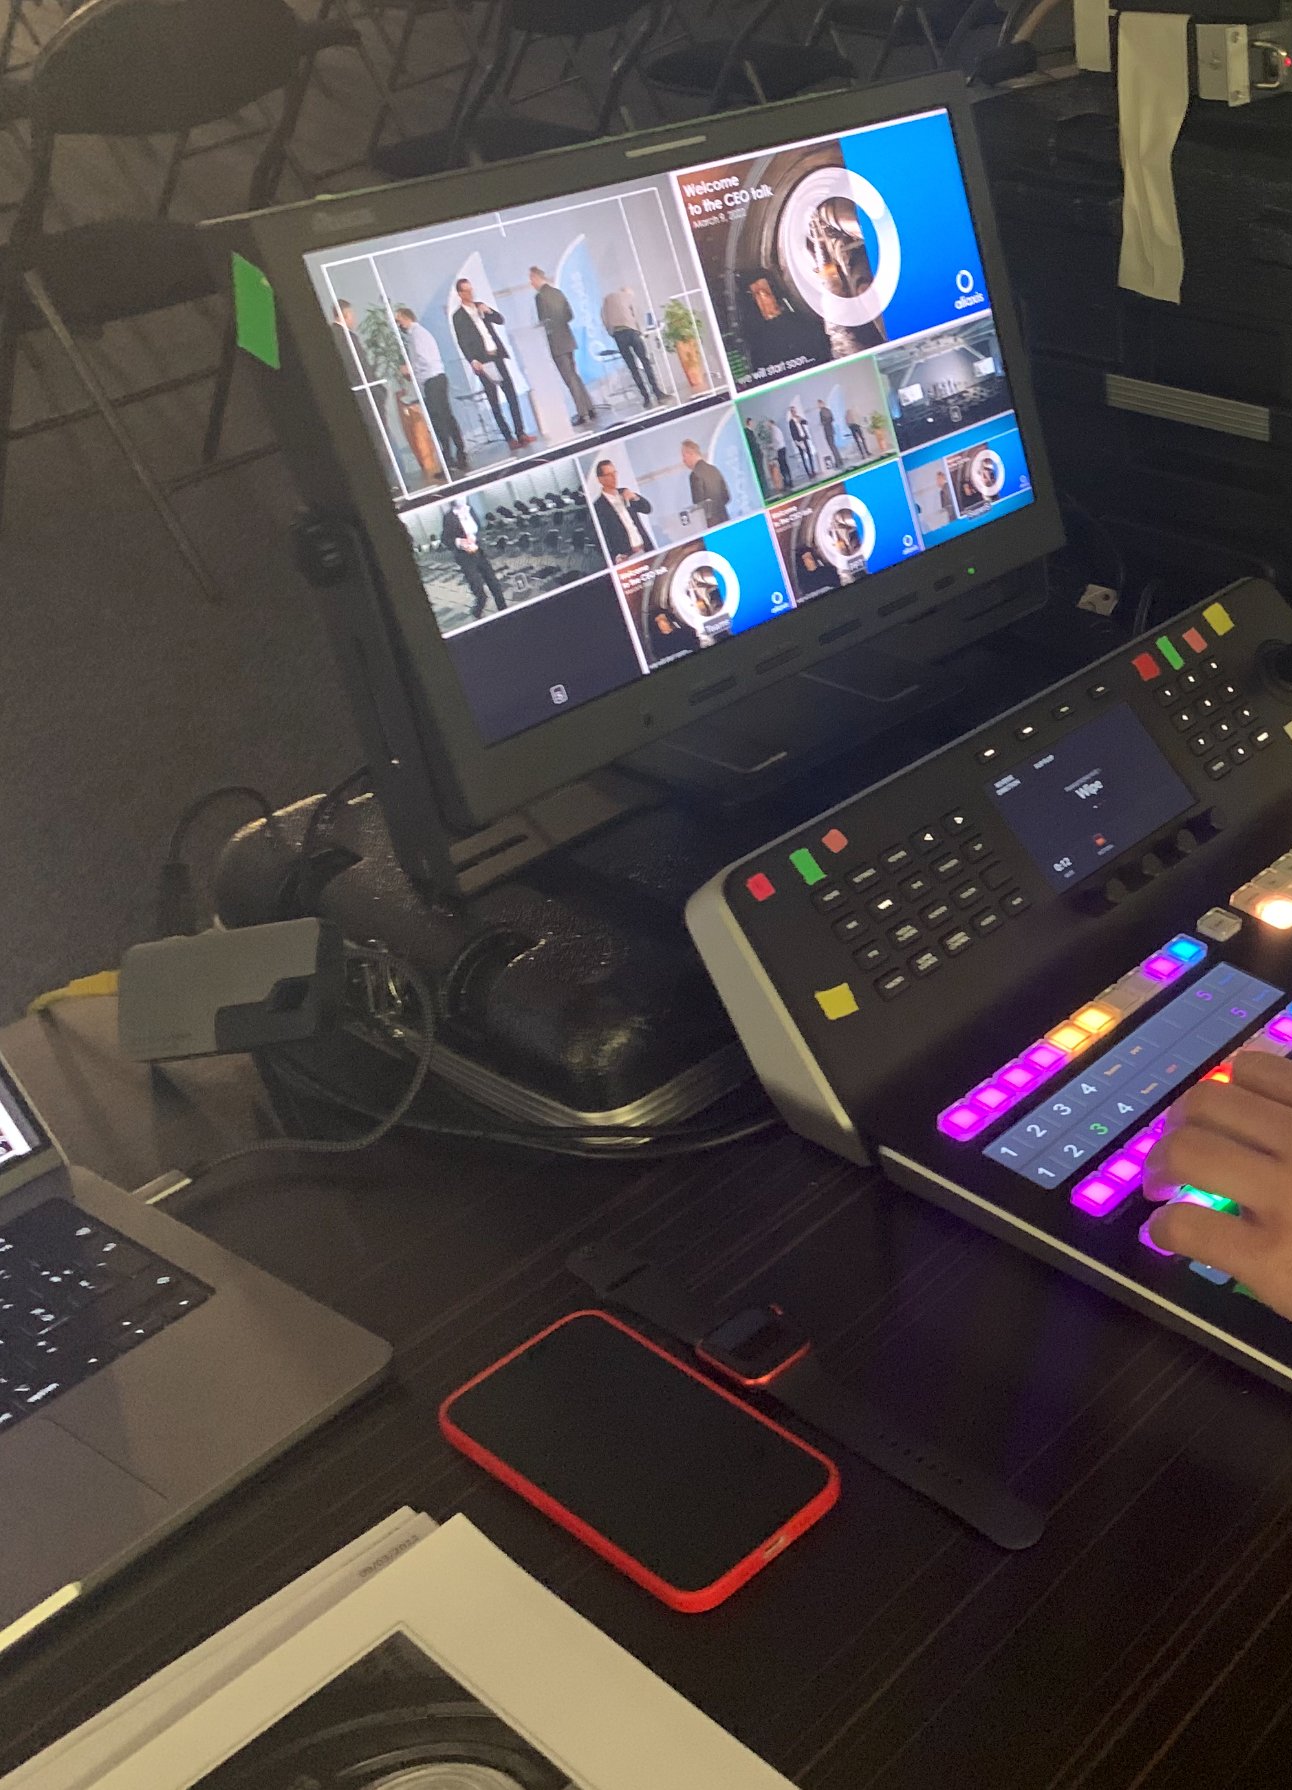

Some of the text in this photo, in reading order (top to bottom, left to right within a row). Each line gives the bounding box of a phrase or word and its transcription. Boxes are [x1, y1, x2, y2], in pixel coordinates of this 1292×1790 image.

[682, 176, 740, 198] Welcome
[688, 184, 774, 216] to the CEO talk
[1000, 1146, 1019, 1157] 1
[1026, 1124, 1048, 1138] 2
[1052, 1103, 1072, 1116] 3
[1080, 1082, 1098, 1095] 4
[1037, 1167, 1056, 1177] 1
[1063, 1144, 1085, 1158] 2
[1089, 1122, 1109, 1135] 3
[1116, 1102, 1135, 1114] 4
